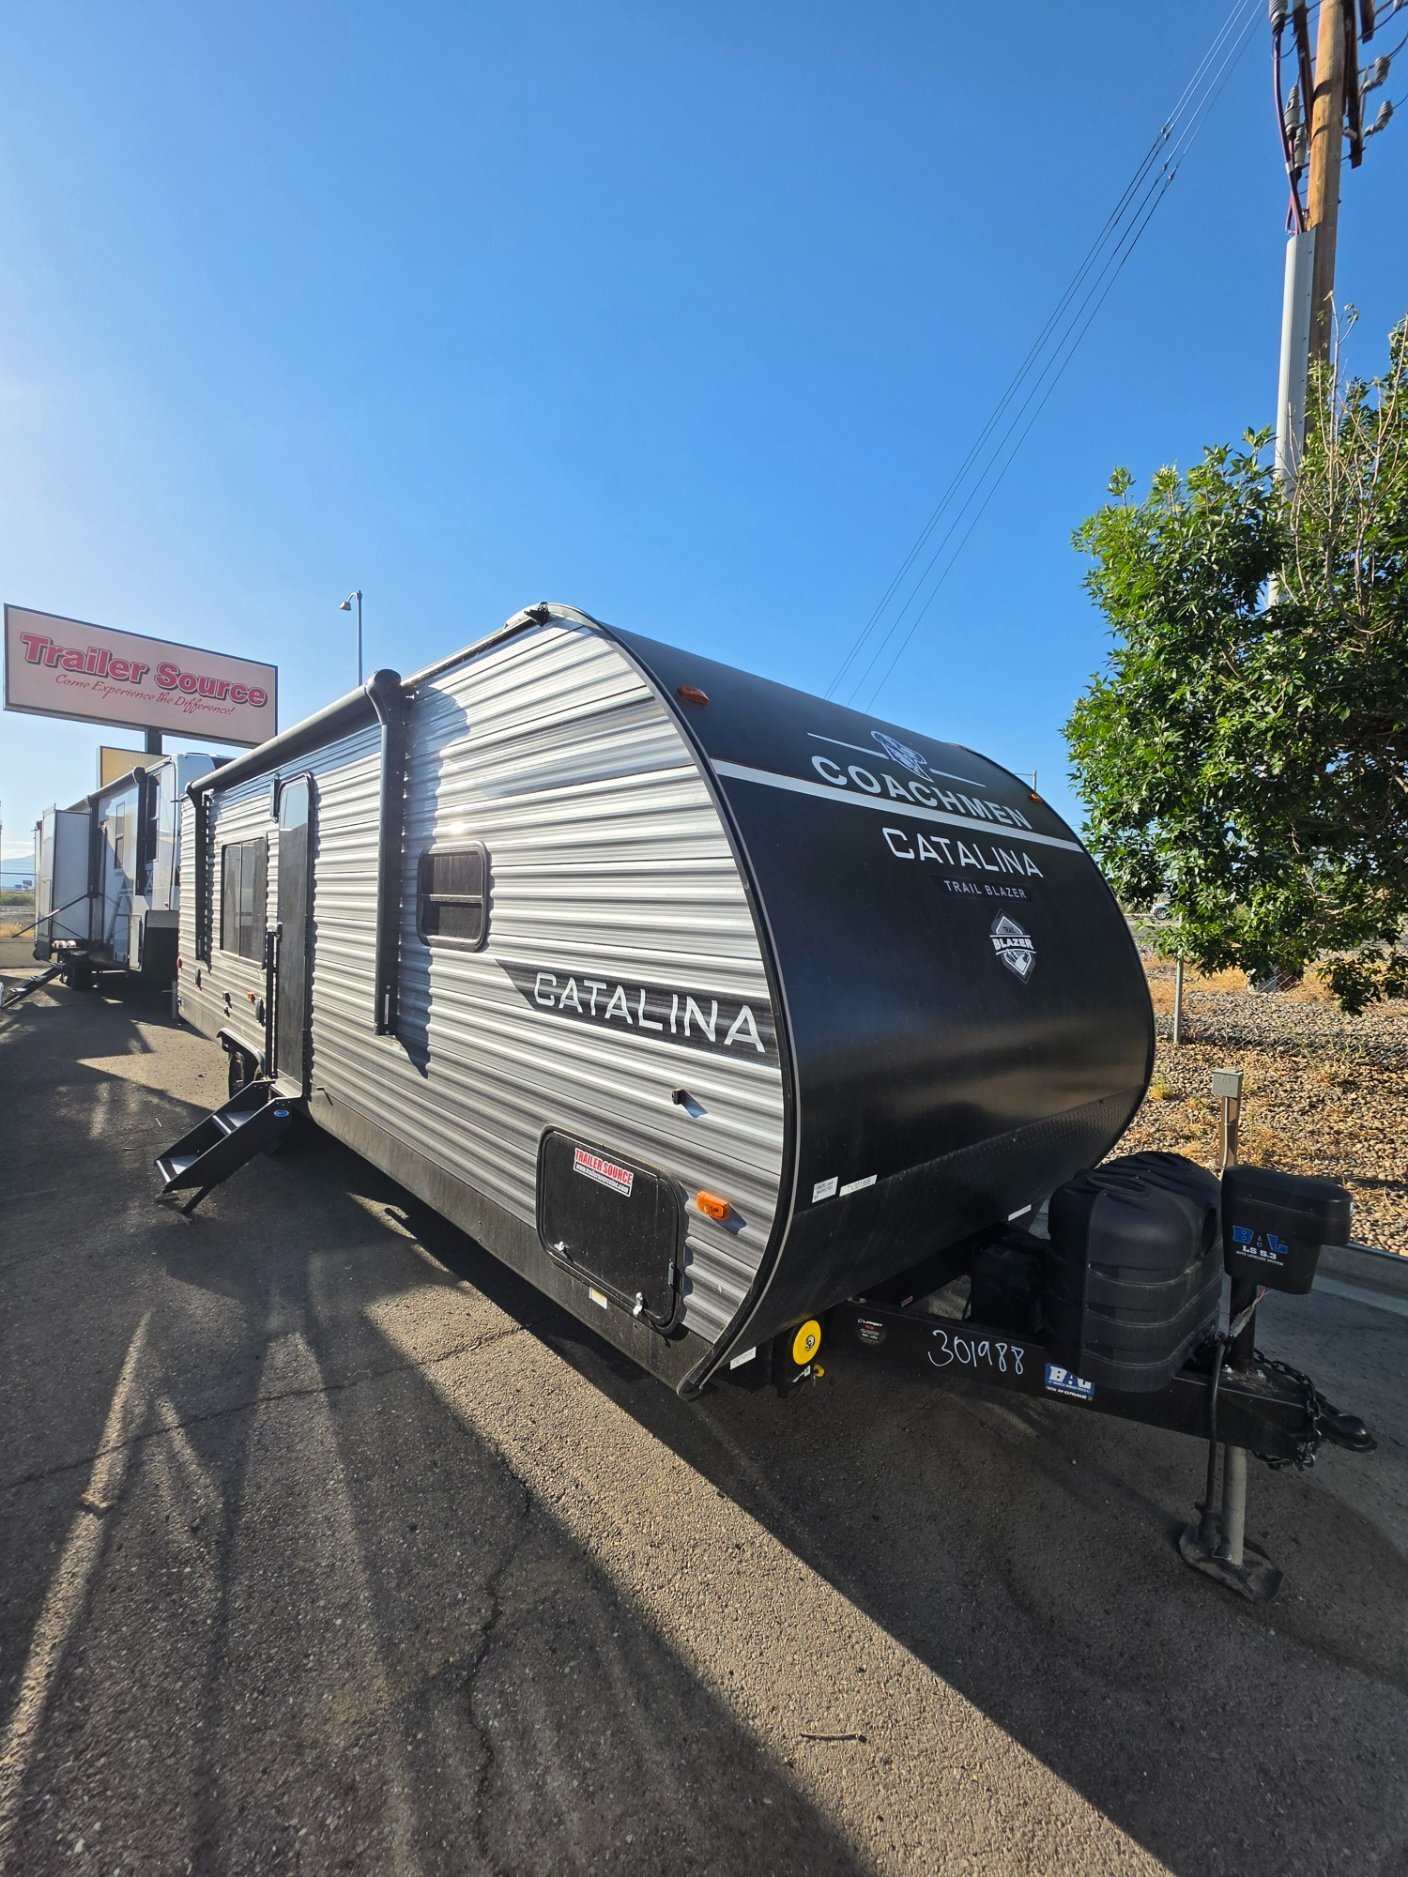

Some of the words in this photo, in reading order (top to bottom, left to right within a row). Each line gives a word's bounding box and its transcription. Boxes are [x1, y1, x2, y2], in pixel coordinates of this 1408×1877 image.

[20, 632, 149, 684] Trailer
[154, 662, 267, 707] Source
[55, 674, 90, 689] Come
[91, 681, 154, 701] Experience
[175, 696, 235, 715] Difference!
[811, 755, 1033, 830] COACHMEN
[882, 827, 1044, 878] CATALINA
[944, 880, 982, 895] TRAIL
[985, 885, 1028, 899] BLAZER
[992, 937, 1034, 951] BLAZER
[534, 972, 765, 1053] CATALINA
[575, 1150, 603, 1171] TRAILER
[603, 1163, 633, 1184] SOURCE
[1242, 1245, 1257, 1254] LS
[927, 1329, 1024, 1376] 301988
